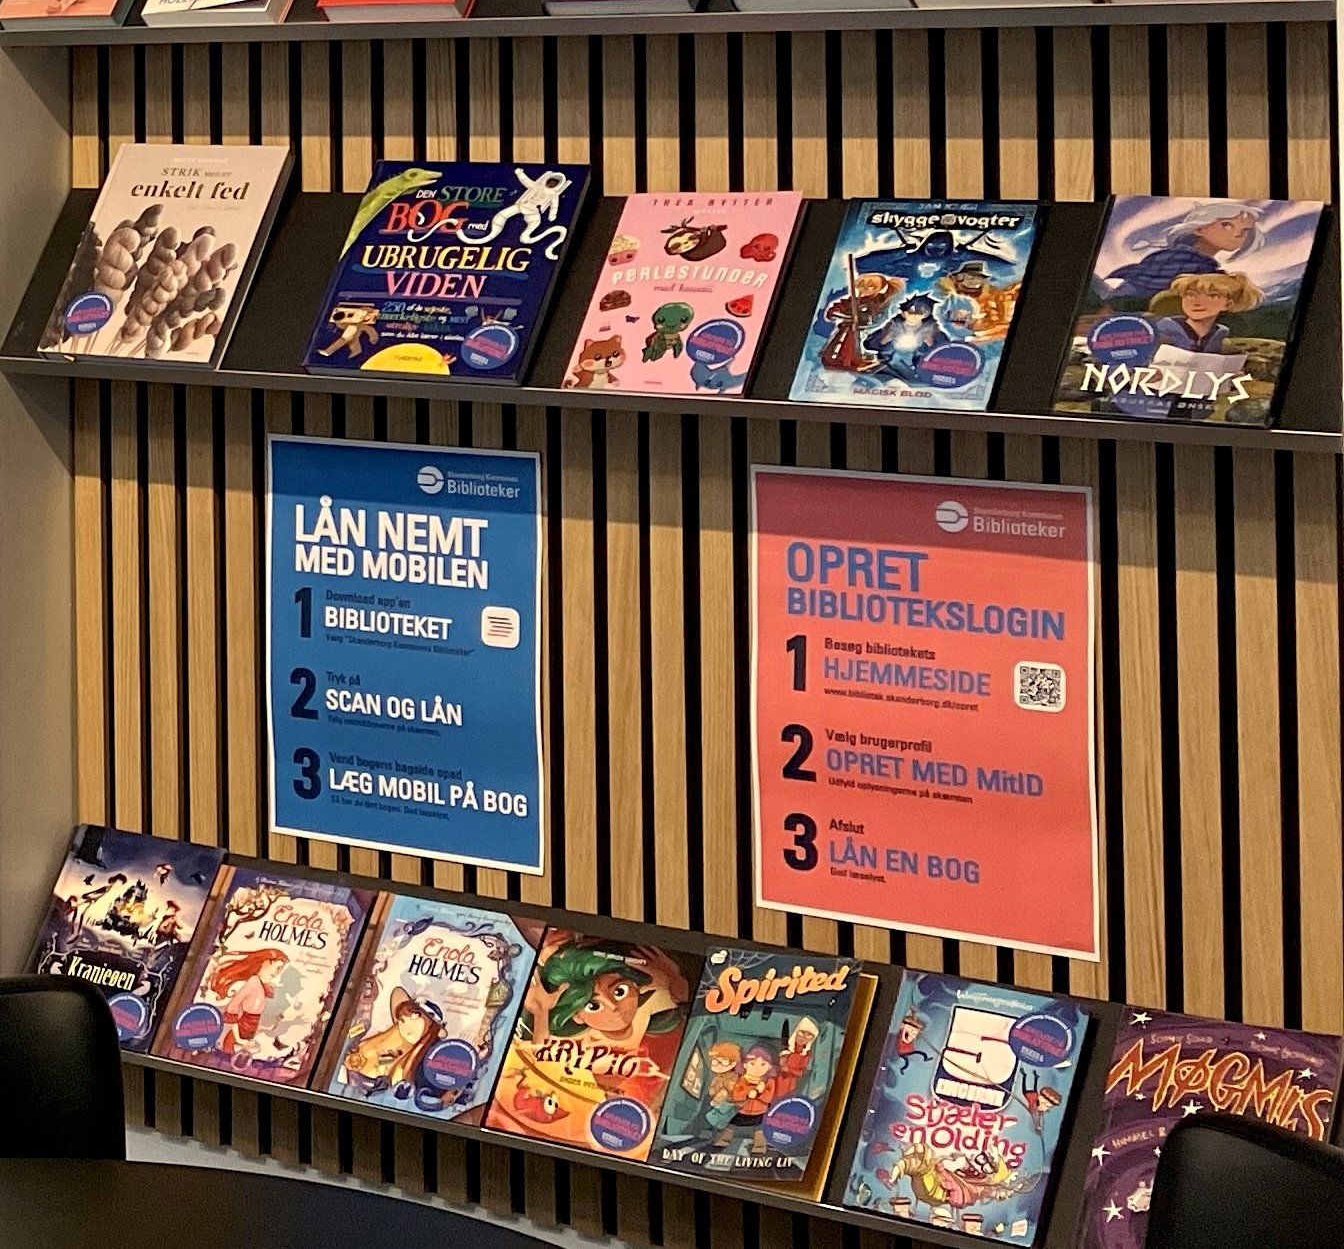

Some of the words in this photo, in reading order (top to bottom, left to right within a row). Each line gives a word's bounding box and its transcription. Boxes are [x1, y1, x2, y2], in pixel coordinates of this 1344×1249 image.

[130, 179, 204, 199] enkelt
[208, 181, 250, 201] fed
[416, 189, 438, 199] DEN
[437, 185, 508, 203] STORE
[384, 199, 470, 234] BOG
[467, 220, 490, 231] med
[361, 245, 533, 272] UBRUGELIG
[385, 270, 488, 299] VIDEN
[1080, 363, 1253, 404] NORDLYS
[447, 480, 520, 498] Biblioteker
[295, 495, 366, 547] LÅN
[378, 511, 488, 557] NEMT
[973, 517, 1065, 538] Biblioteker
[295, 544, 354, 577] MED
[363, 550, 488, 590] MOBILEN
[787, 542, 929, 592] OPRET
[294, 587, 312, 638] 1
[324, 606, 453, 640] BIBLIOTEKET
[788, 587, 1065, 640] BIBLIOTEKSLOGIN
[786, 635, 806, 692] 1
[824, 638, 862, 654] Besøg
[866, 642, 936, 660] bibliotekets
[289, 667, 319, 720] 2
[326, 671, 346, 685] Tryk
[349, 675, 361, 686] på
[823, 657, 991, 696] HJEMMESIDE
[325, 688, 381, 716] SCAN
[386, 696, 415, 720] OG
[421, 696, 462, 726] LÅN
[781, 723, 816, 783] 2
[825, 728, 856, 746] Vælg
[860, 733, 932, 753] brugerprofil
[292, 747, 322, 800] 3
[329, 752, 353, 766] Vend
[357, 756, 392, 770] bogens
[437, 768, 462, 780] opad
[827, 748, 904, 779] OPRET
[912, 759, 968, 787] MED
[977, 767, 1044, 797] MitID
[329, 768, 372, 795] LÆG
[378, 774, 445, 806] MOBIL
[450, 781, 479, 811] PÅ
[483, 789, 528, 818] BOG
[783, 812, 819, 871] 3
[829, 818, 865, 835] Afslut
[830, 836, 877, 869] LÅN
[886, 848, 919, 875] EN
[927, 855, 980, 884] BOG
[259, 920, 330, 950] HOLMES
[274, 904, 327, 932] Enola
[408, 953, 483, 985] HOLMES
[422, 937, 479, 965] Enola
[67, 955, 137, 992] Kranieøen
[704, 965, 851, 1015] Spirited
